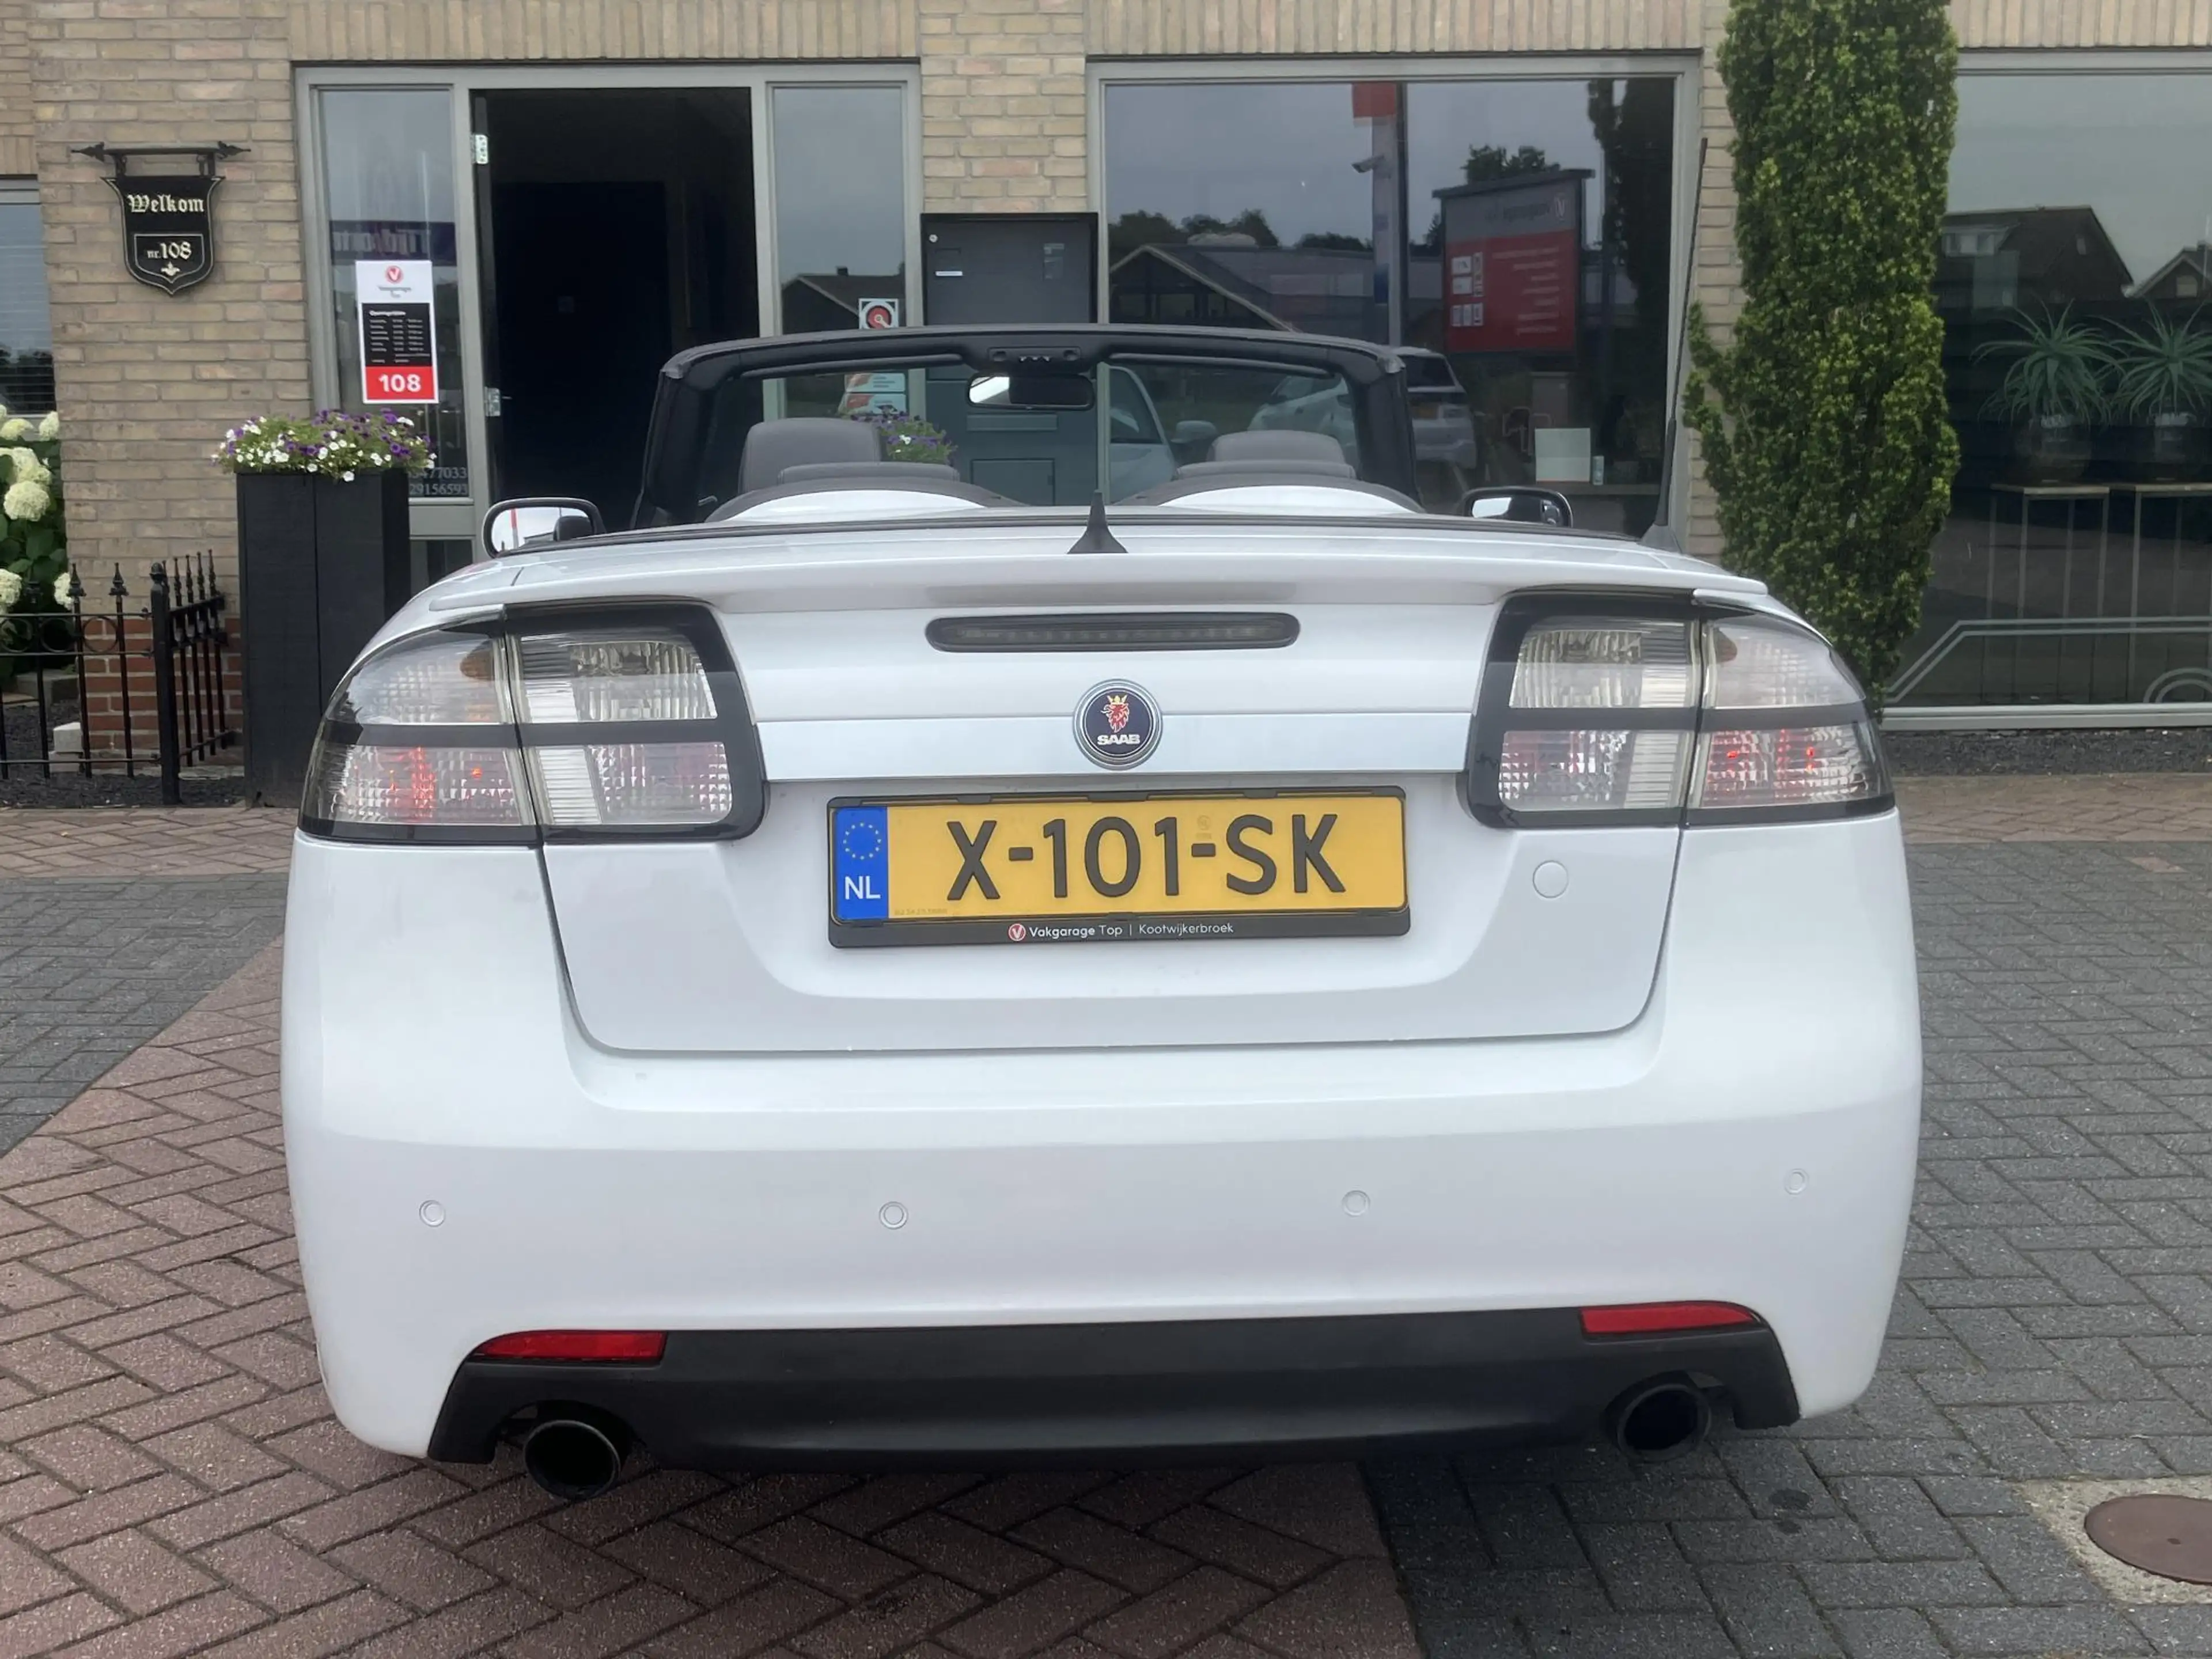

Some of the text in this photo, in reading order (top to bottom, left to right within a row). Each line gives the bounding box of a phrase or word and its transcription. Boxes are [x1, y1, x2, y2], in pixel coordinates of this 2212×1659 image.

[127, 194, 204, 213] Welkom
[379, 374, 422, 392] 108
[1097, 734, 1141, 745] SAAB
[946, 813, 1346, 901] X-101-SK
[844, 875, 881, 900] NL
[1029, 926, 1095, 939] Vakgarage
[1099, 924, 1123, 937] Top
[1139, 922, 1234, 937] Kootwijkerbroek
